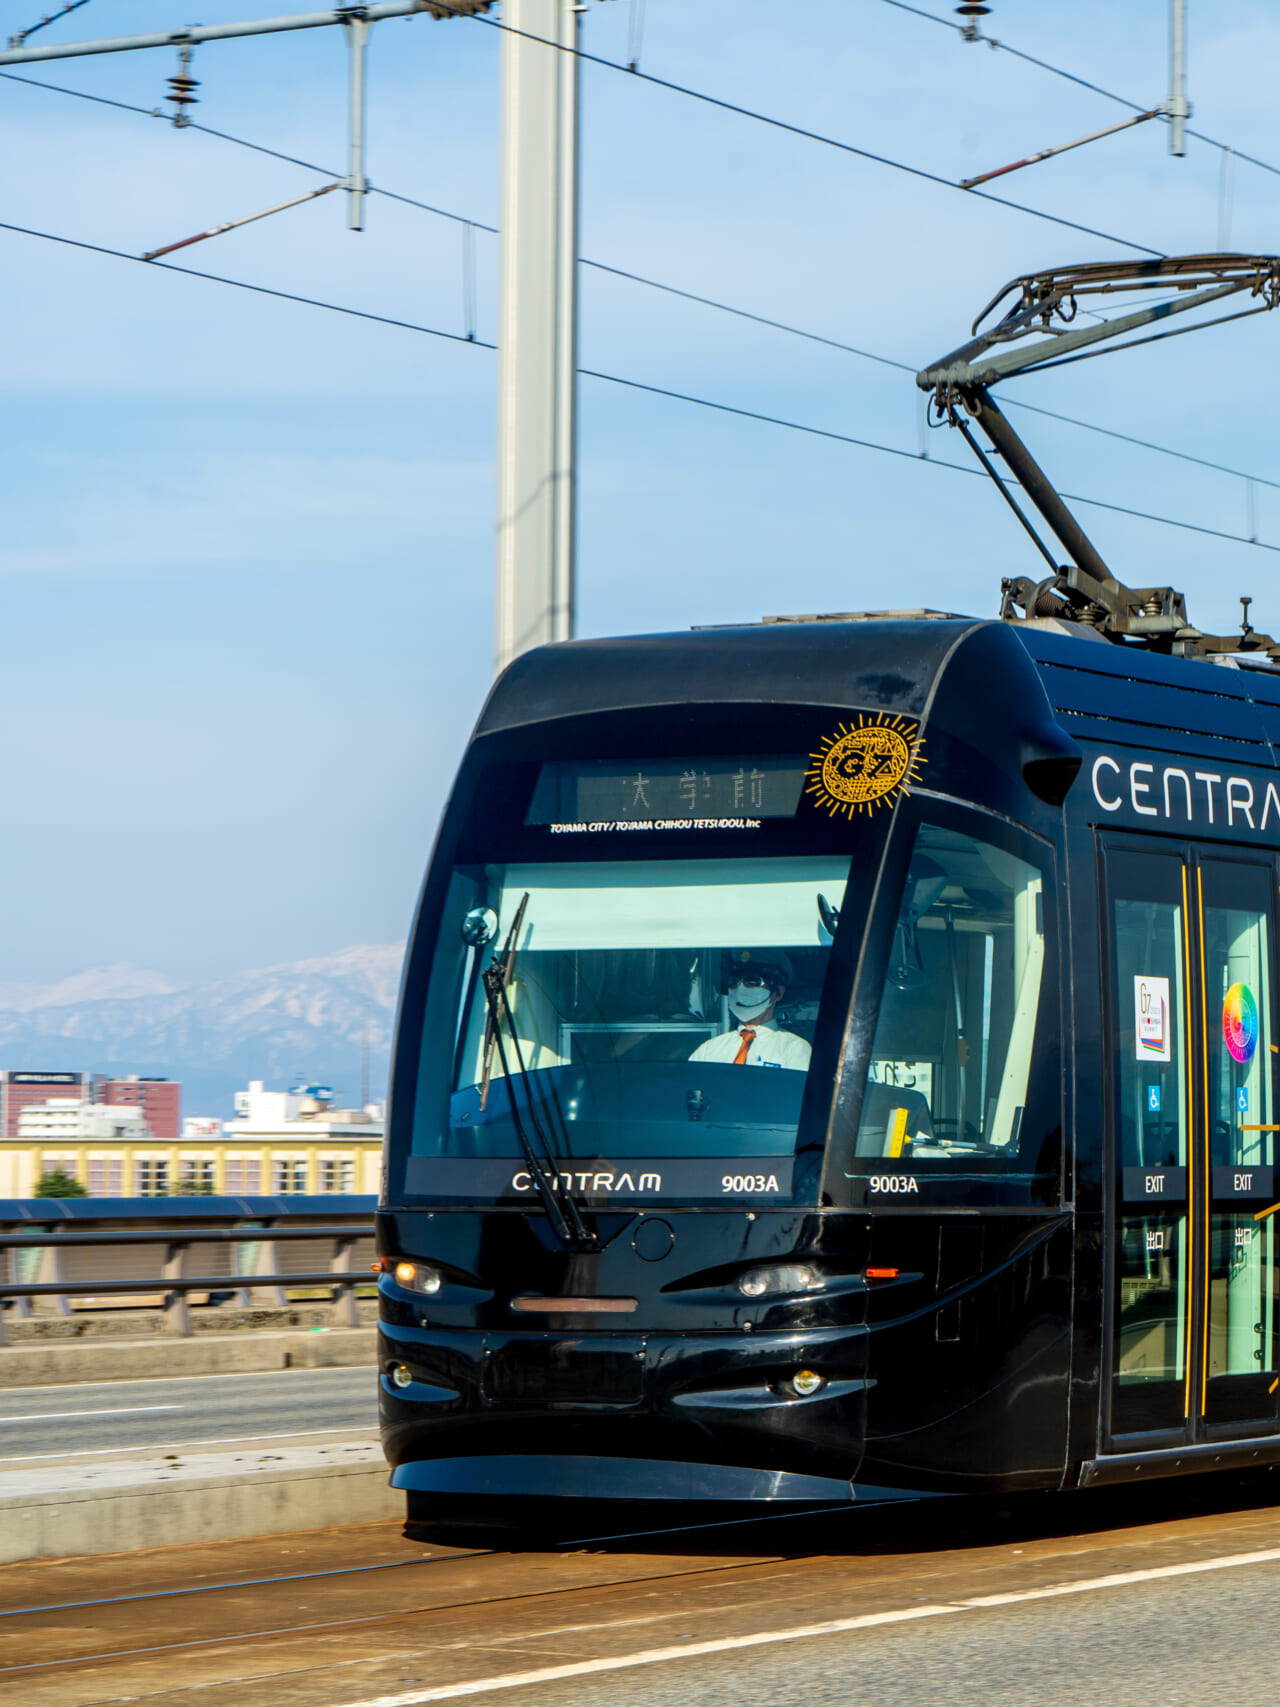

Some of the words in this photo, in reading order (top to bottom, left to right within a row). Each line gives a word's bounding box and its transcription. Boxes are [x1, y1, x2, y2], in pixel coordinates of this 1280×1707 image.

[550, 822, 588, 834] TOYAMA
[588, 822, 610, 833] CITY
[616, 820, 653, 831] TOYAMA
[654, 819, 693, 830] CHIHOU
[746, 819, 761, 829] Inc
[721, 1175, 779, 1193] 9003A
[869, 1176, 919, 1193] 9003A
[1145, 1175, 1165, 1193] EXIT
[1234, 1173, 1253, 1191] EXIT
[1146, 1231, 1164, 1250] 出口
[1234, 1227, 1252, 1246] 出口
